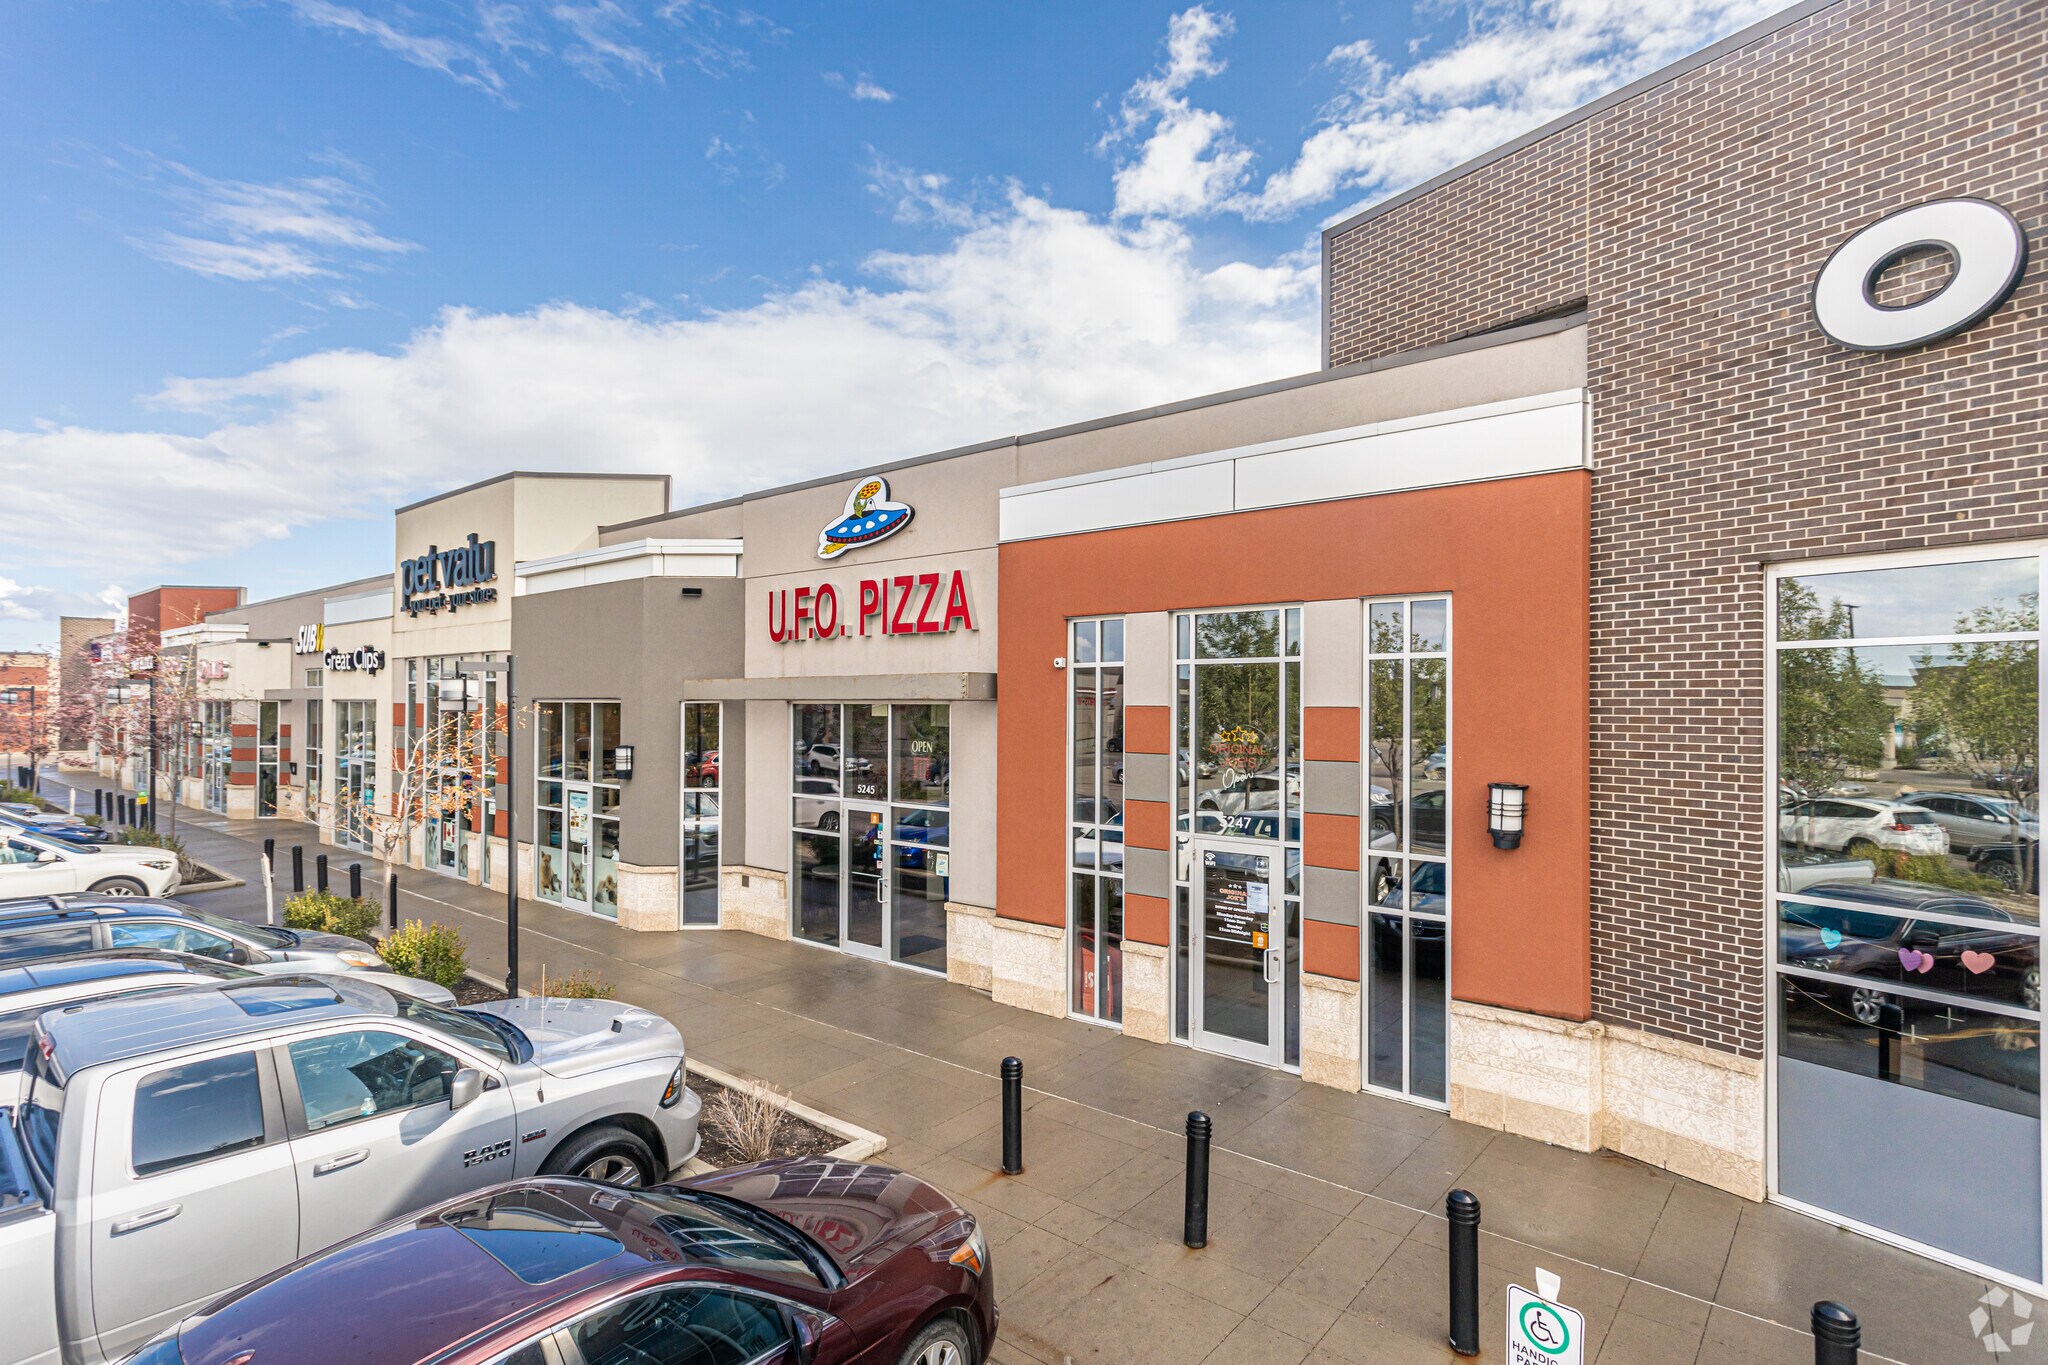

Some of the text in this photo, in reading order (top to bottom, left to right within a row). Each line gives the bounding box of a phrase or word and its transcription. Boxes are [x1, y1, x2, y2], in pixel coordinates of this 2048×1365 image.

[400, 532, 495, 612] pet valu
[769, 569, 976, 643] U.F.O. PIZZA
[324, 646, 380, 675] Great Clips
[911, 740, 933, 753] OPEN
[1209, 743, 1268, 756] ORIGINAL
[1222, 768, 1254, 788] Open
[857, 784, 876, 795] 5245
[1219, 816, 1252, 829] 5247
[464, 1138, 511, 1160] RAM
[464, 1147, 511, 1168] 1500
